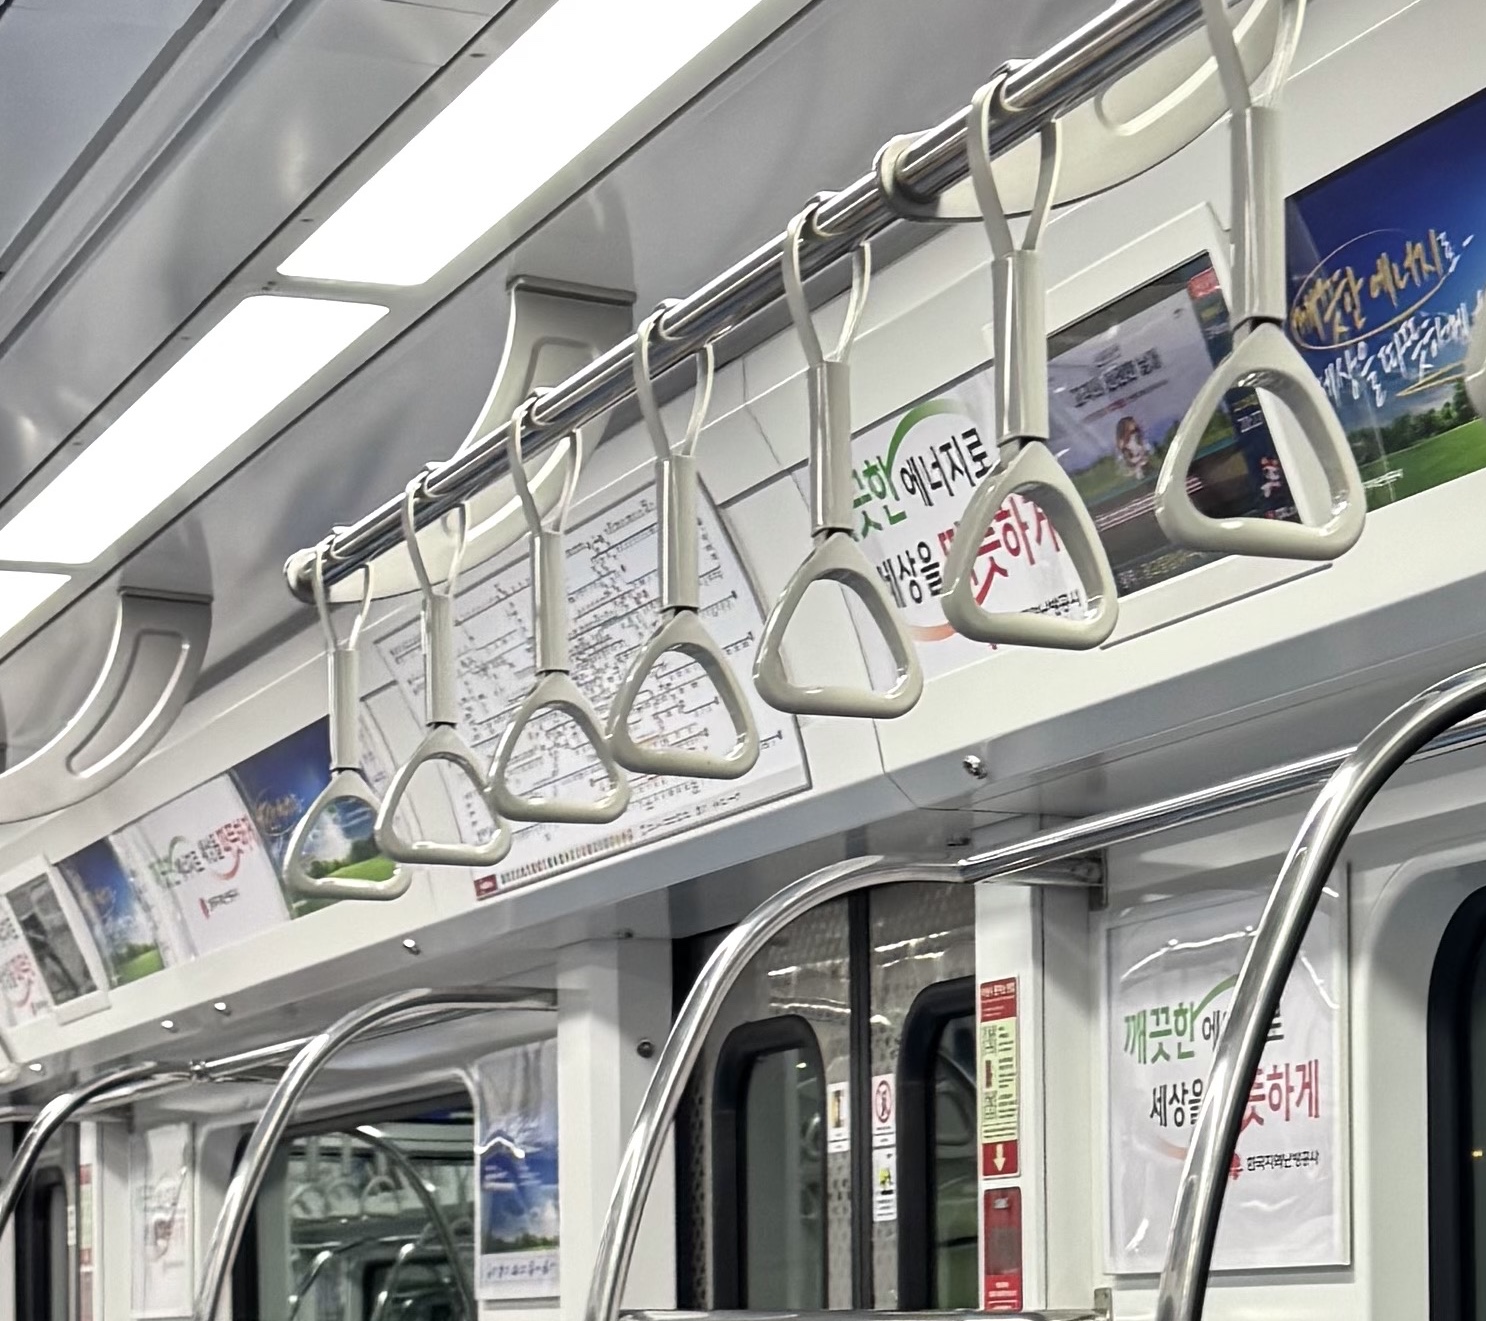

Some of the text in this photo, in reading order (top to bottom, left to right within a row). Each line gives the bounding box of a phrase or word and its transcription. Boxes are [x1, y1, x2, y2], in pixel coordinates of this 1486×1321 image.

[852, 427, 993, 541] 끗한 에너지로
[876, 541, 943, 608] 세상을
[1124, 1002, 1195, 1065] 깨끗한
[1150, 1058, 1320, 1134] 세상을 뜻하게
